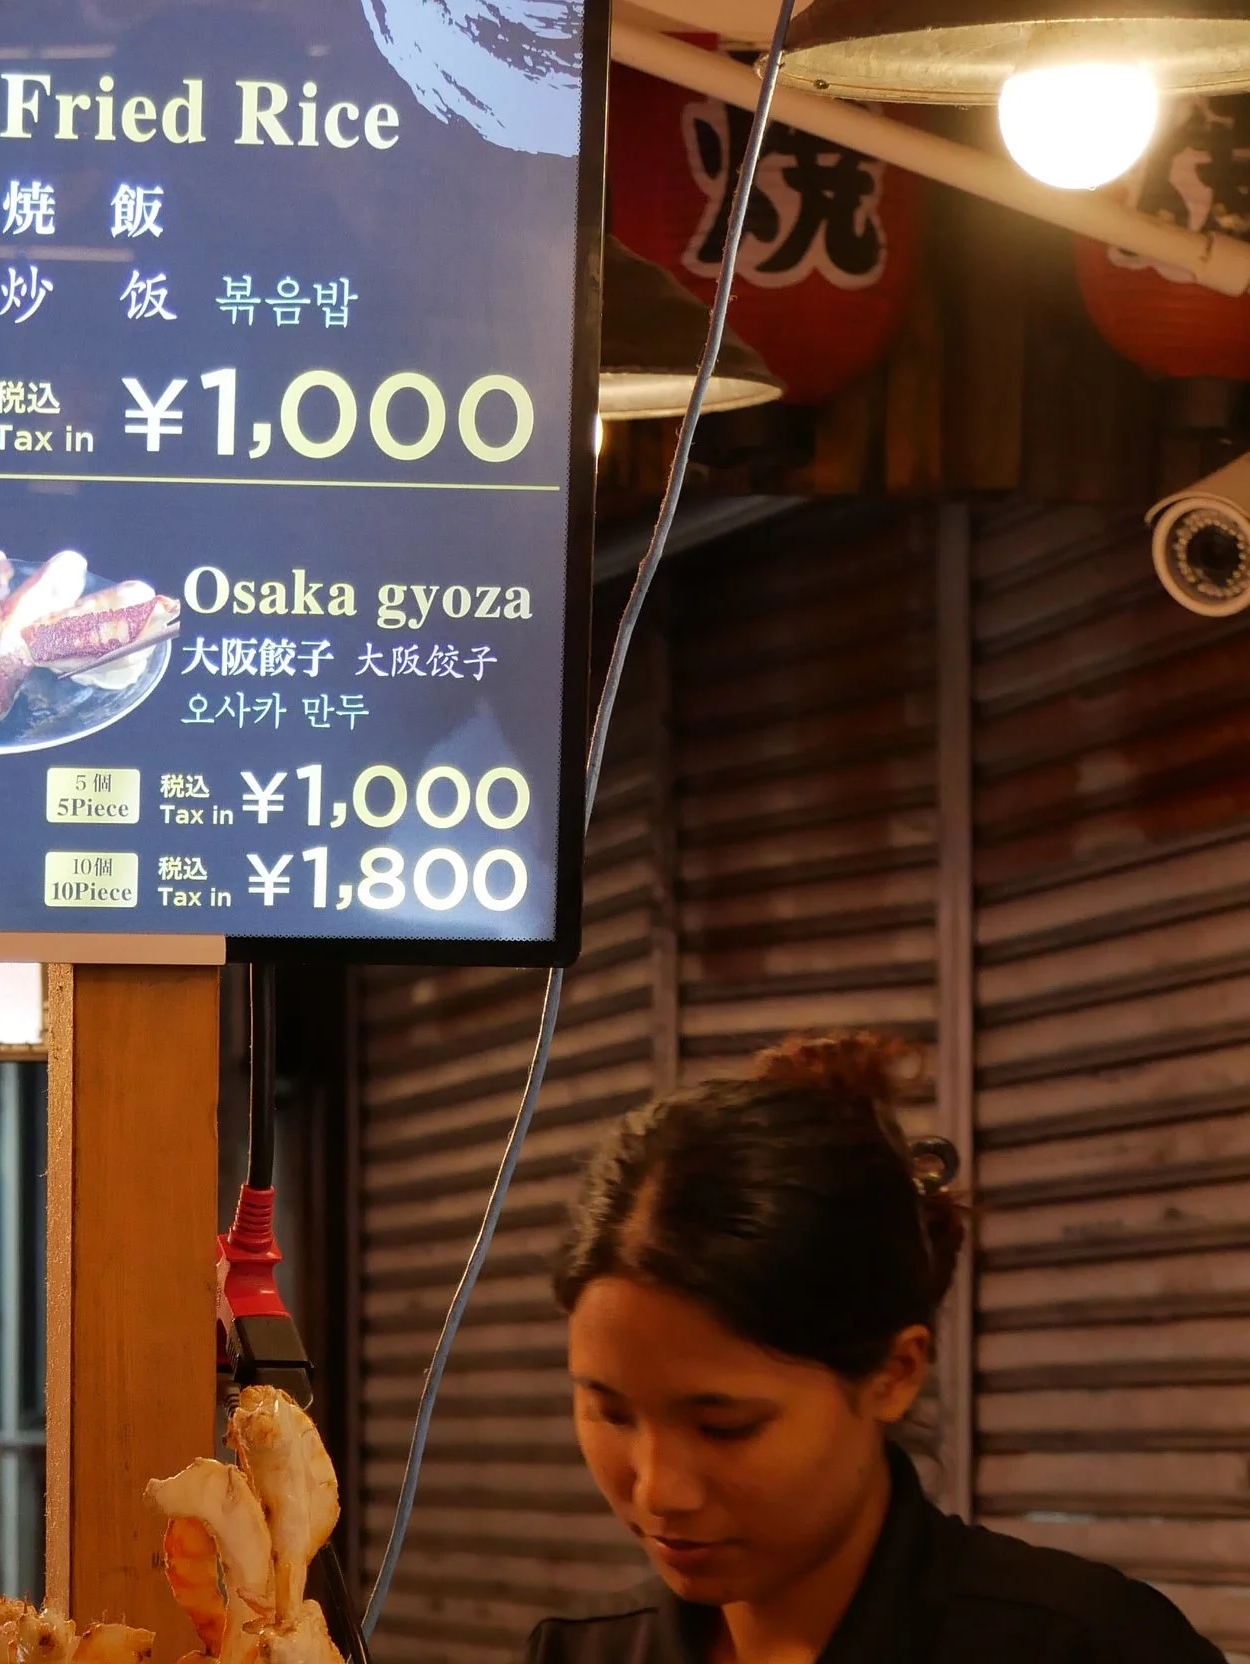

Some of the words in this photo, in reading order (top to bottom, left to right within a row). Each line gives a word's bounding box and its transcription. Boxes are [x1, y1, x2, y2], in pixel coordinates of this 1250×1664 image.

[0, 72, 206, 145] Fried
[234, 79, 400, 150] Rice
[216, 274, 358, 328] 볶음밥
[121, 367, 535, 462] ¥1,000
[65, 425, 94, 452] in
[184, 565, 357, 616] Osaka
[376, 582, 533, 629] gyoza
[181, 637, 335, 678] 大阪餃子
[355, 642, 498, 681] 大阪饺子
[181, 691, 287, 729] 오사카
[302, 694, 370, 731] 만두
[75, 773, 112, 794] 5個
[160, 774, 210, 798] 税込
[240, 764, 530, 830] ¥1,000
[57, 798, 129, 819] 5Piece
[160, 805, 204, 825] Tax
[212, 804, 234, 826] in
[72, 857, 113, 877] 10個
[158, 856, 208, 881] 税込
[246, 846, 528, 912] ¥1,800
[50, 883, 132, 903] 10Piece
[158, 887, 202, 907] Tax
[210, 887, 232, 908] in
